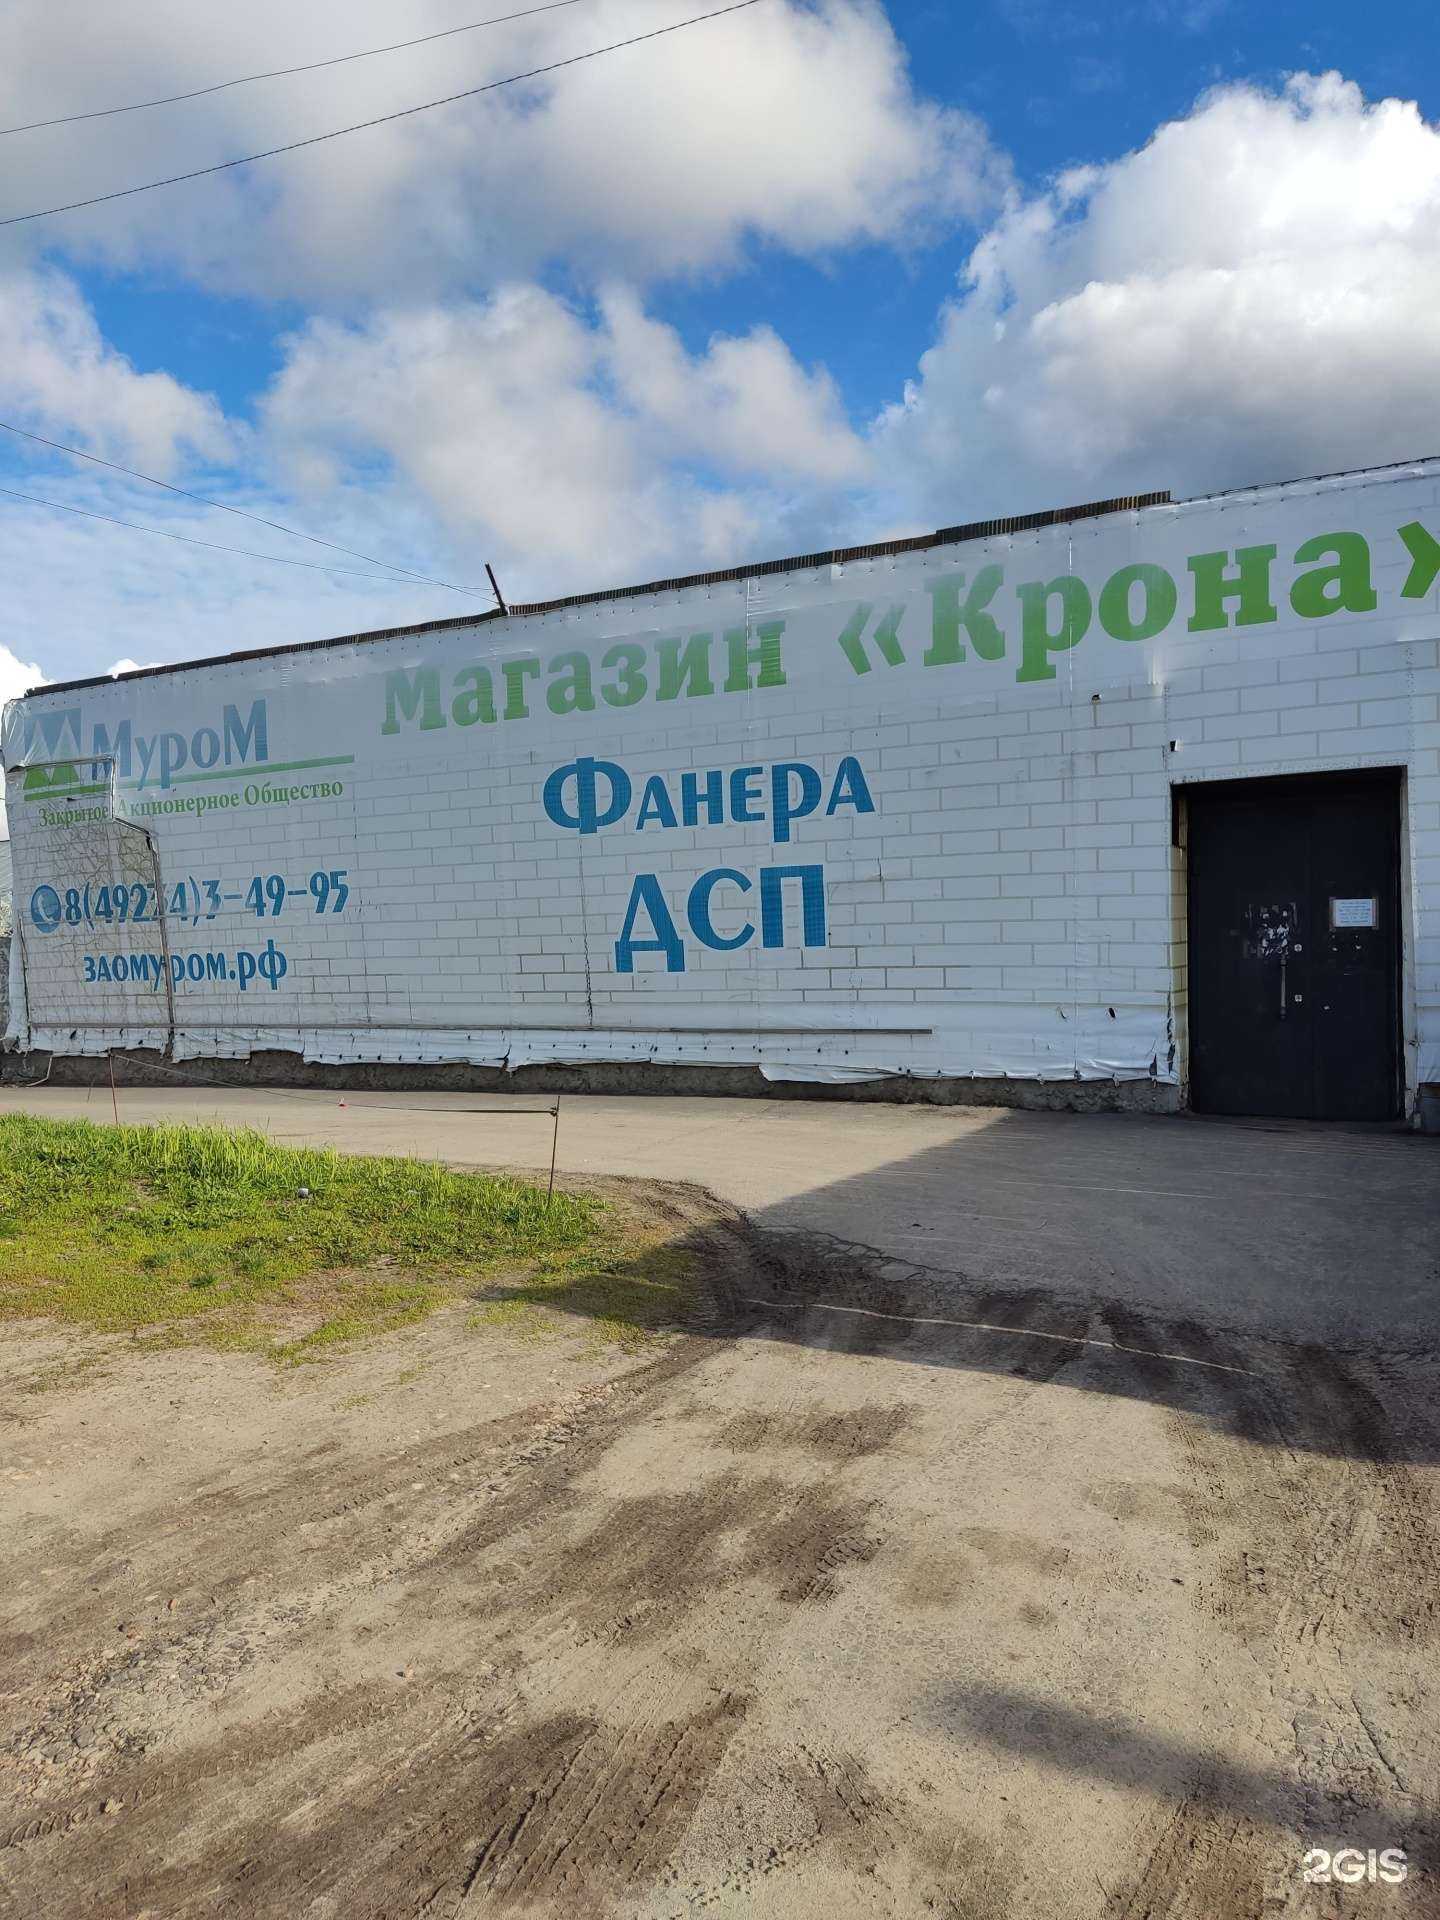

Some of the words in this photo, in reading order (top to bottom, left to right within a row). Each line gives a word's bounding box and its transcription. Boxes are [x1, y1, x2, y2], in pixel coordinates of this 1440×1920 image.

[118, 791, 240, 818] Акционерное
[244, 781, 344, 807] Общество
[614, 864, 826, 972] ДСП
